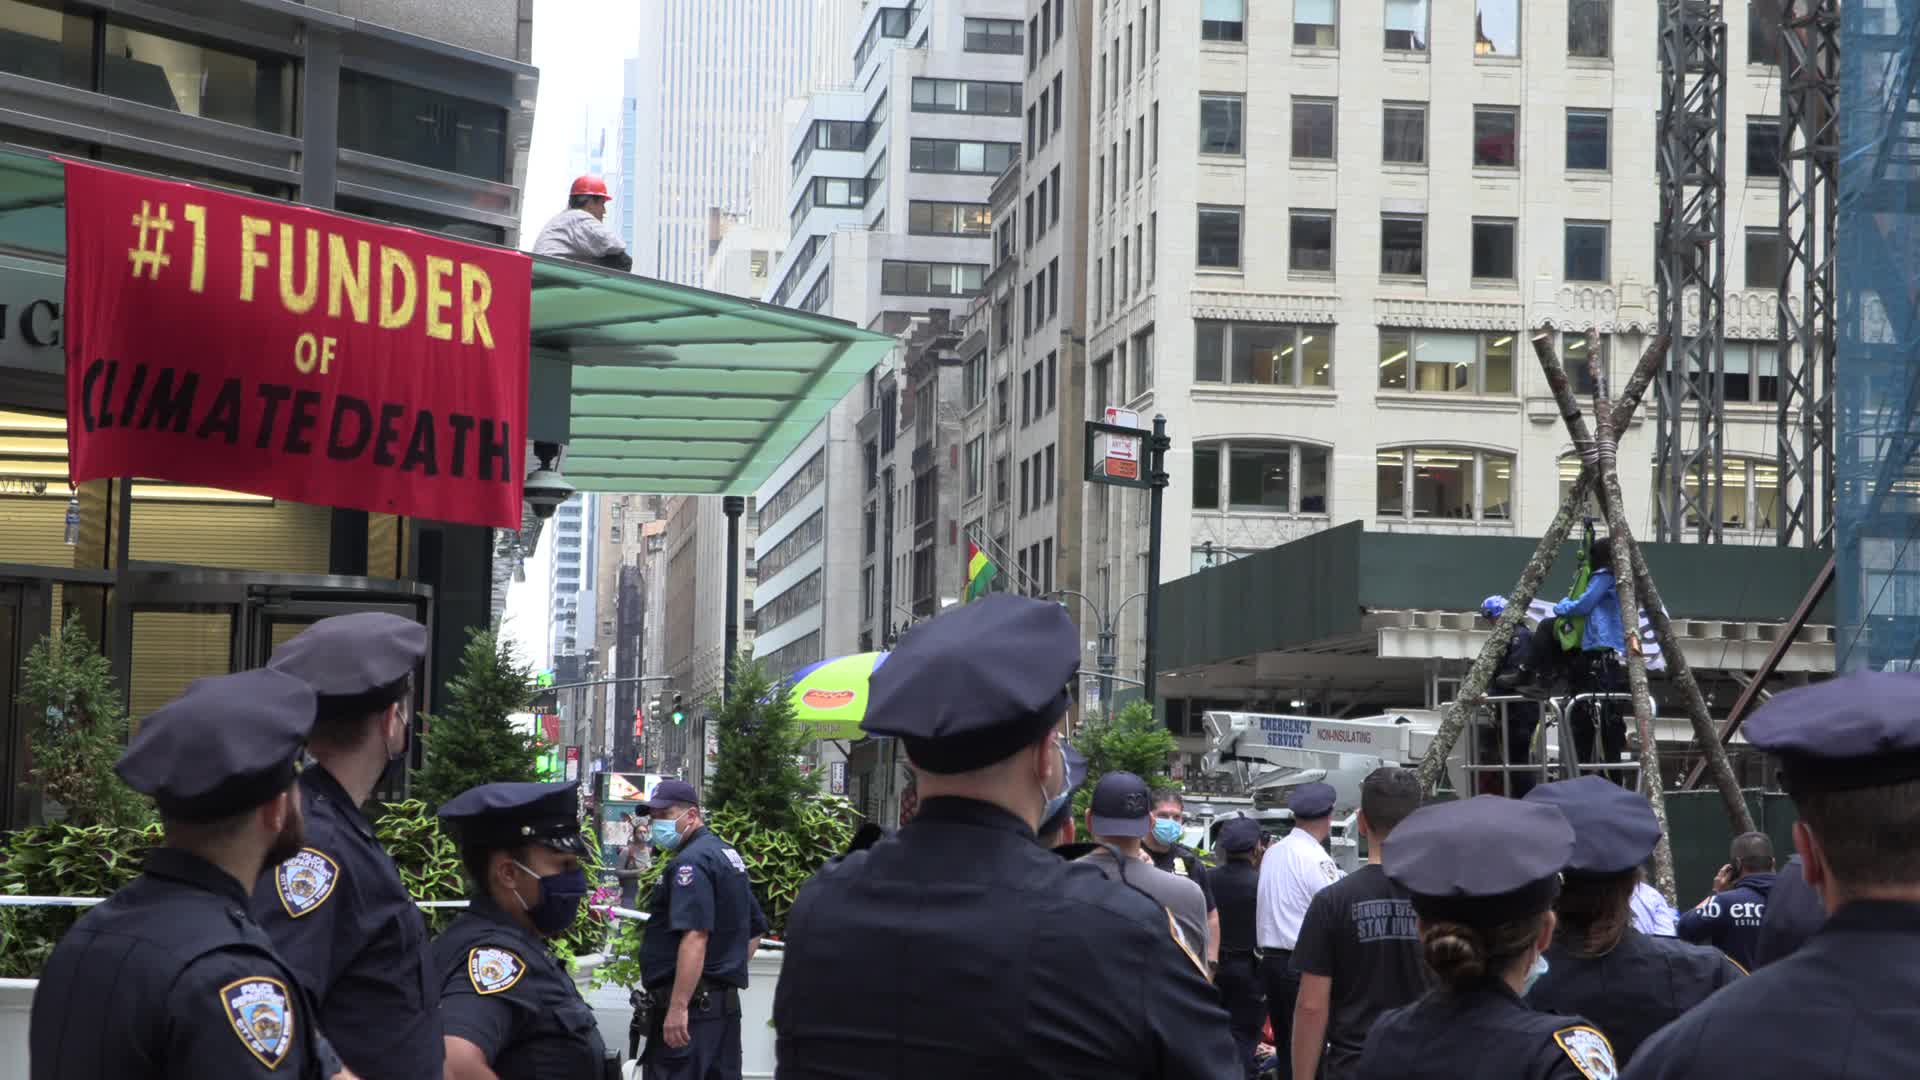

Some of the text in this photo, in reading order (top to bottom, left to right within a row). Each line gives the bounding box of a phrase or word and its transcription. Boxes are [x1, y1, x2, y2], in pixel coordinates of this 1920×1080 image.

[129, 200, 496, 349] #1 FUNDER
[294, 332, 337, 375] OF
[1260, 717, 1312, 735] EMERGENCY
[1267, 733, 1303, 748] SERVICE
[1317, 728, 1371, 744] NON-INSULATING
[1358, 917, 1388, 938] STAY
